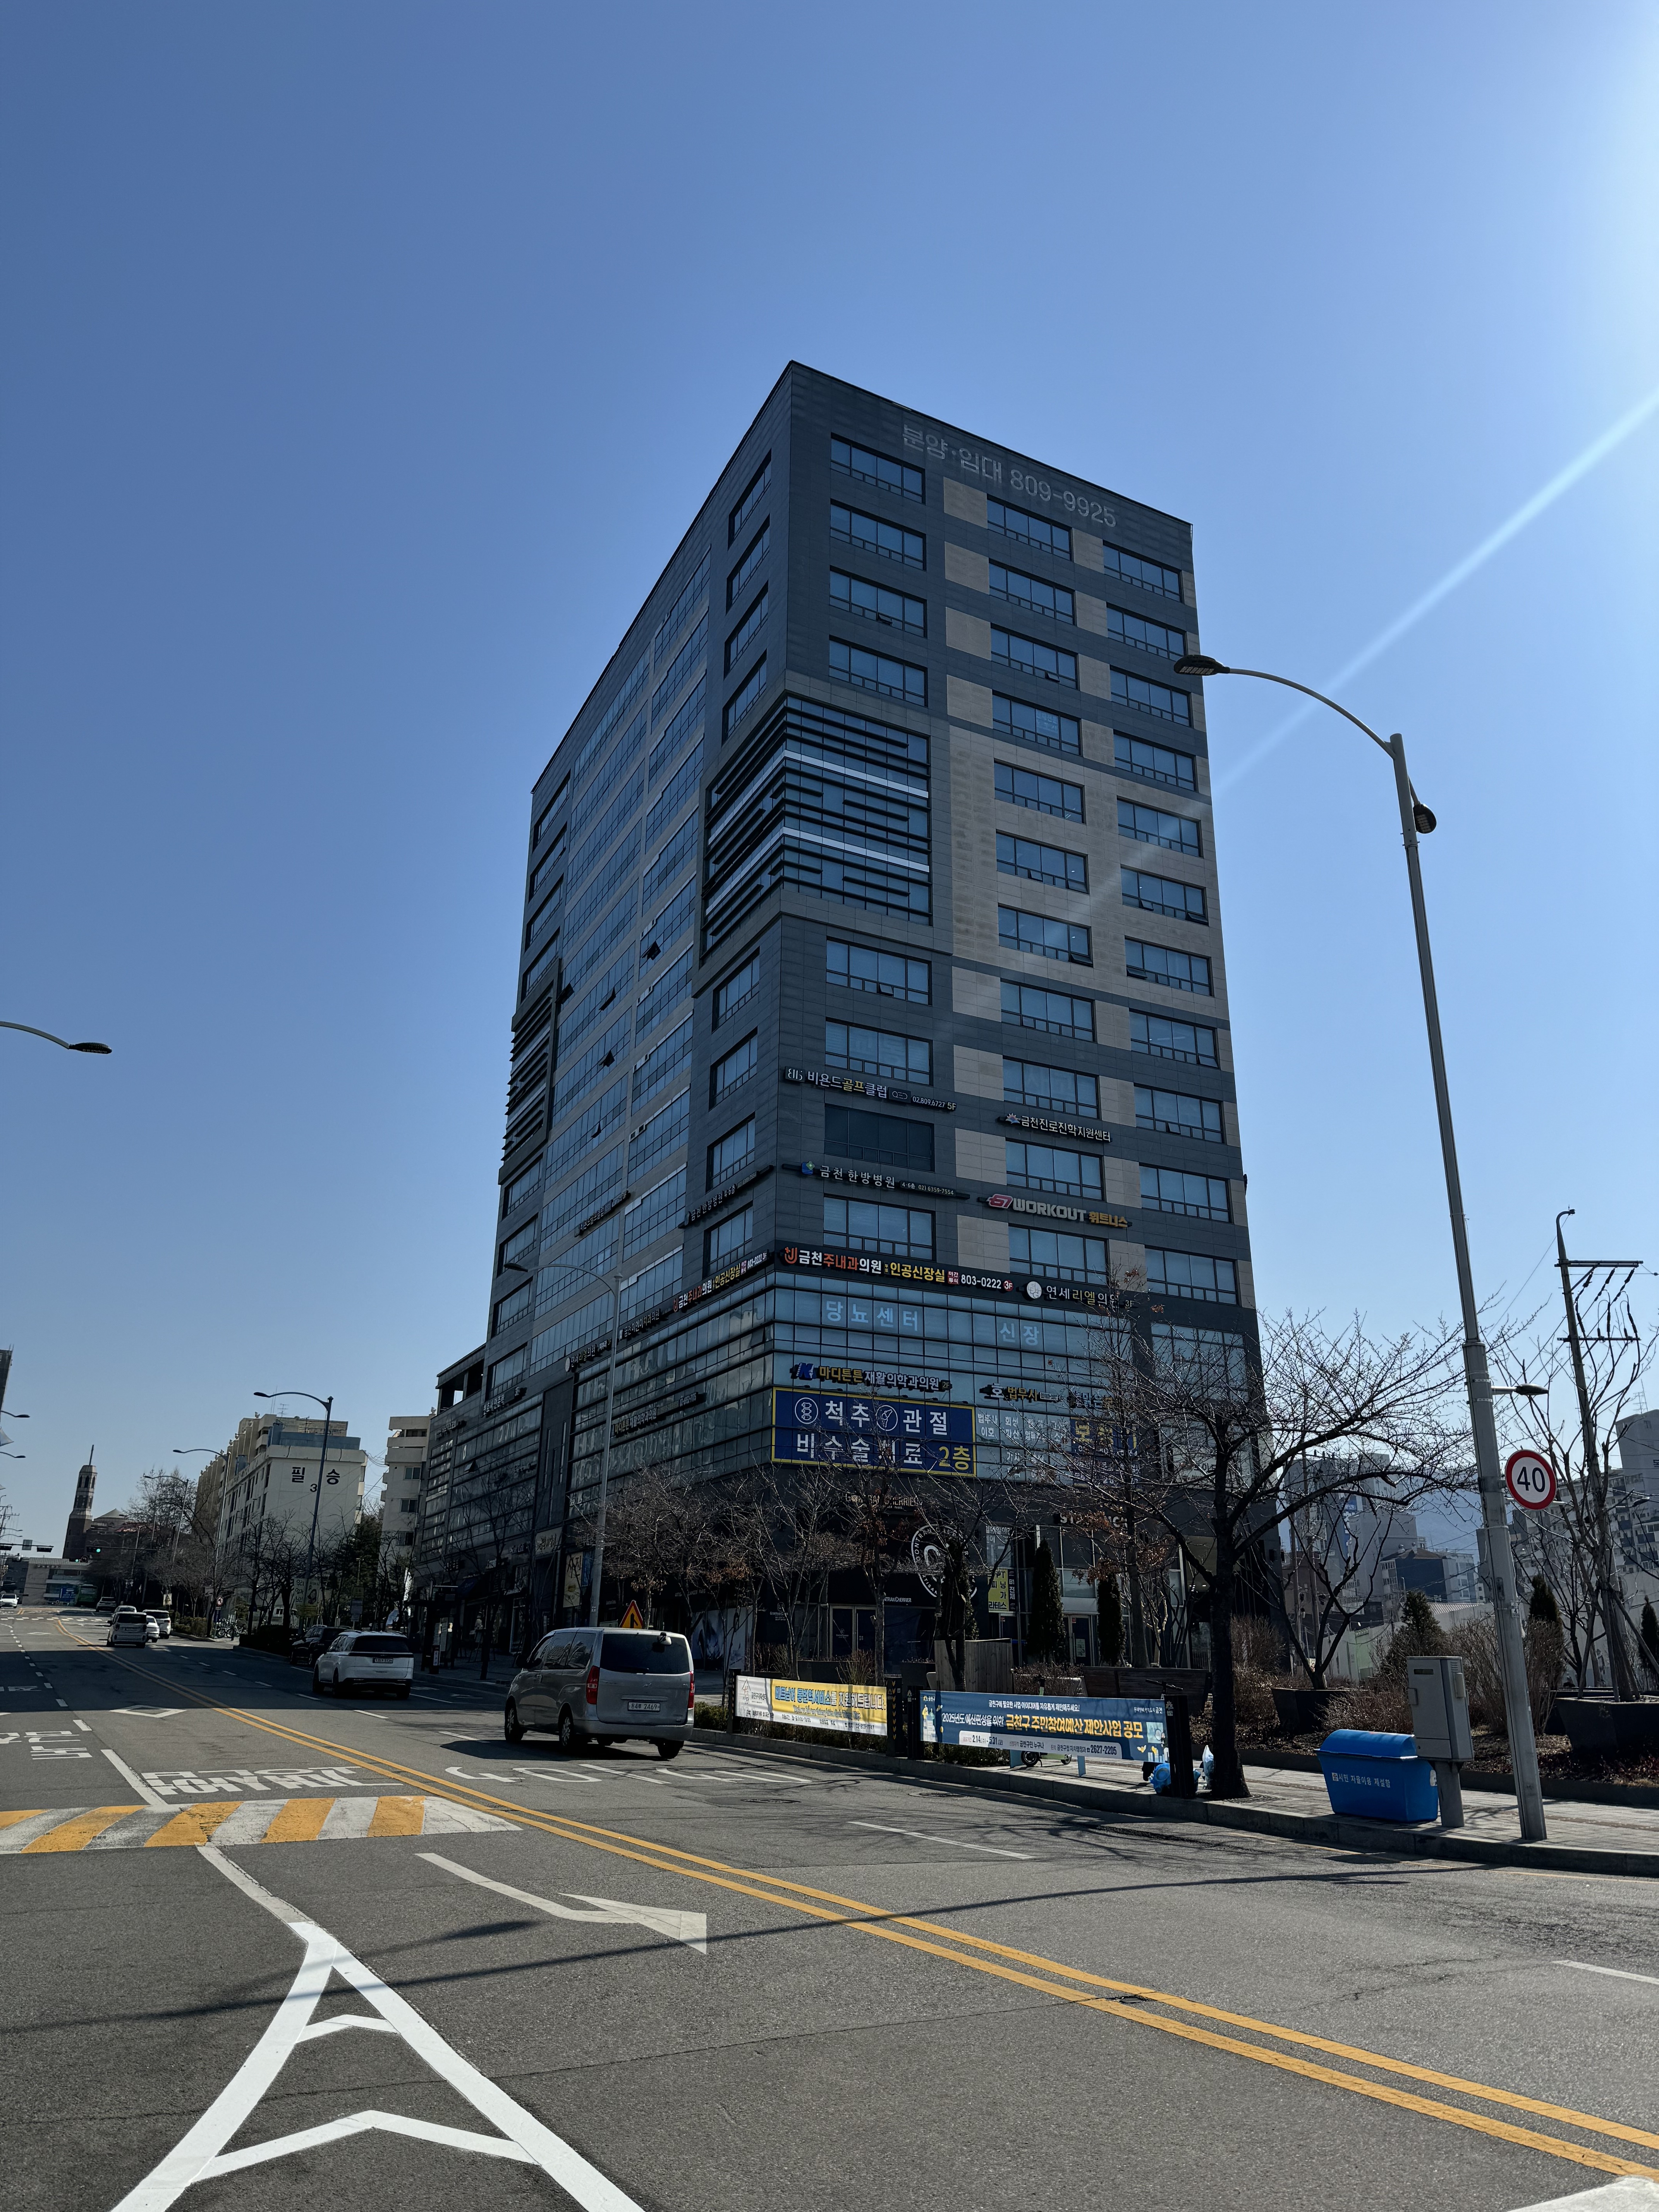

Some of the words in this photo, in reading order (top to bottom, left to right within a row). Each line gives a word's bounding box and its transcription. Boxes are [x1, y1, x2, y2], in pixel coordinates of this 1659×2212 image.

[1010, 469, 1116, 527] 809-9925
[808, 1071, 887, 1099] 비욘드골프클럽
[912, 1096, 945, 1108] 02.809.6727
[1021, 1116, 1111, 1142] 금천진로진학지원센터
[820, 1165, 843, 1181] 금천
[847, 1169, 895, 1189] 한방병원
[928, 1186, 954, 1195] 6359-7554
[691, 1206, 701, 1221] 금천
[1013, 1198, 1087, 1222] WORKOUT
[1089, 1211, 1128, 1228] 휘트니스
[799, 1250, 881, 1274] 금천주내과의원
[891, 1262, 945, 1283] 인공신장실
[961, 1274, 1001, 1289] 803-0222
[1004, 1280, 1013, 1289] 3F
[678, 1279, 712, 1309] 금천주내과의원
[715, 1263, 740, 1289] 인공신장실
[826, 1300, 918, 1331] 당뇨센터
[1000, 1322, 1039, 1346] 신장
[1007, 1386, 1037, 1401] 법무사
[825, 1400, 870, 1427] 척추
[903, 1409, 947, 1436] 관절
[981, 1427, 994, 1437] 이호
[938, 1445, 970, 1470] 2층
[310, 1483, 317, 1492] 3
[1517, 1466, 1546, 1492] 40
[775, 1686, 795, 1702] 베트남어
[989, 1700, 1003, 1708] 금천구에
[1021, 1702, 1040, 1710] 아이디어를
[1040, 1702, 1055, 1711] 자유롭게
[942, 1713, 965, 1724] 2025년도
[965, 1714, 992, 1726] 예산편성을
[993, 1715, 1004, 1727] 위한
[1006, 1714, 1030, 1729] 금천구
[1031, 1715, 1084, 1735] 주민참여예산
[1084, 1718, 1122, 1737] 제안사업
[1123, 1721, 1144, 1739] 공모
[1034, 1741, 1044, 1749] 누구나
[1090, 1745, 1117, 1755] 2627-2205
[1374, 1778, 1391, 1788] 제설함
